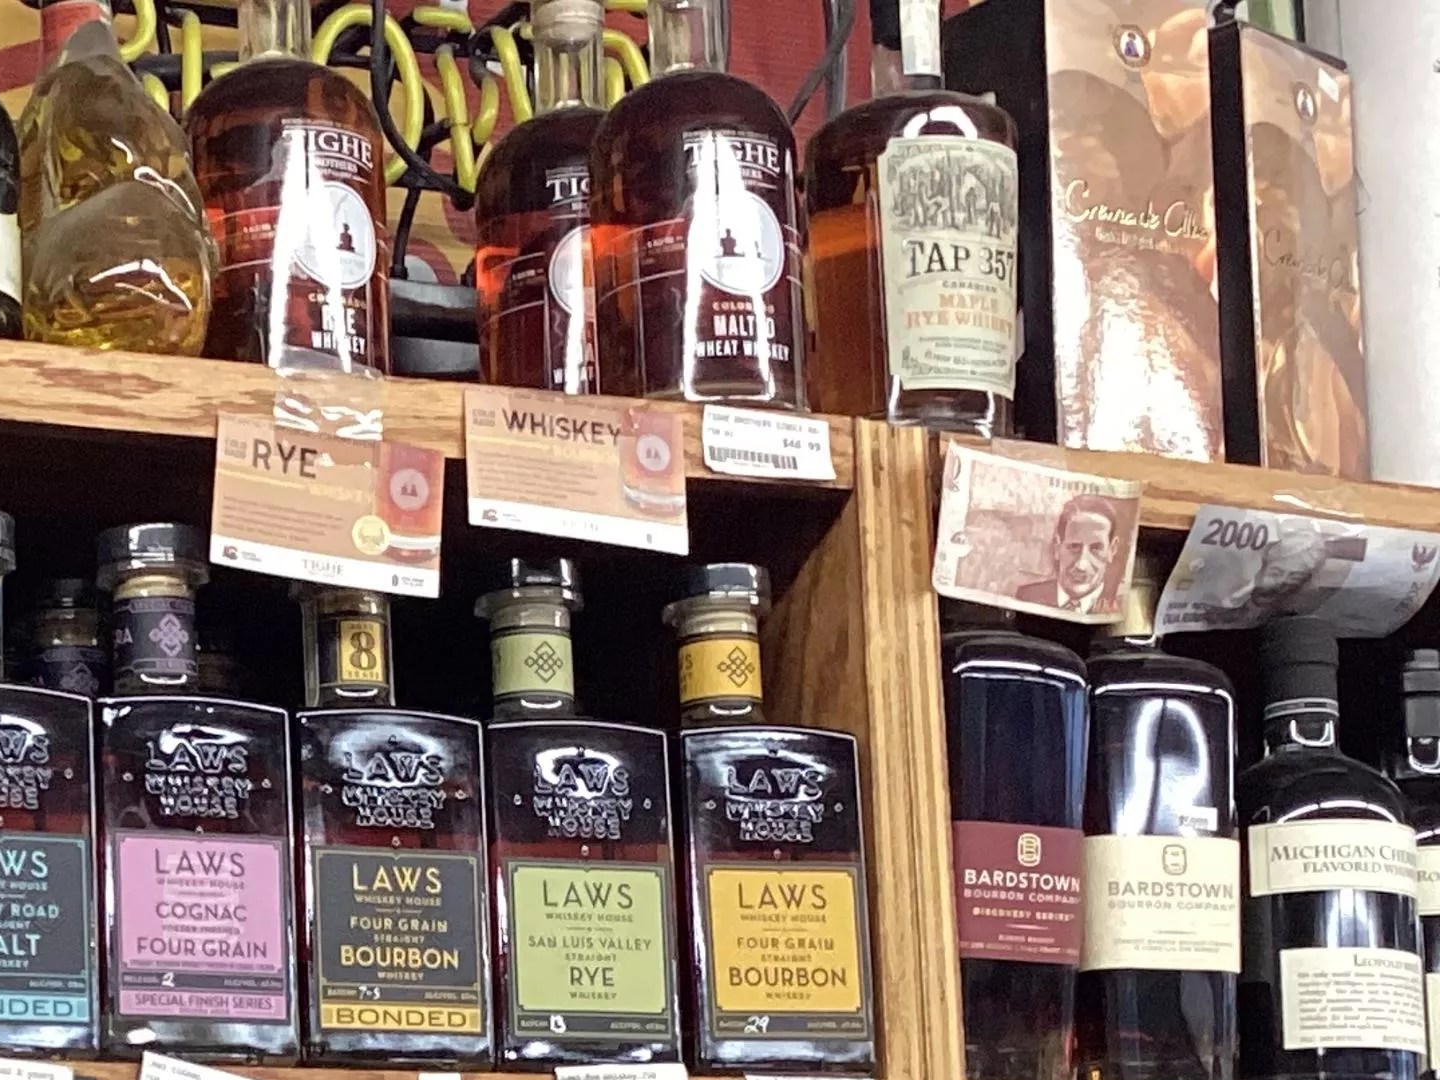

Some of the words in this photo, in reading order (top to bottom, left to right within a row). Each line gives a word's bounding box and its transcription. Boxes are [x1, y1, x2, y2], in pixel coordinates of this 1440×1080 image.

[906, 240, 970, 279] TAP
[980, 248, 1014, 288] 357
[501, 407, 622, 448] WHISKEY
[252, 439, 319, 479] RYE
[1202, 519, 1269, 551] 2000
[349, 631, 376, 671] 8
[155, 848, 246, 878] LAWS
[1271, 844, 1376, 862] MICHIGAN
[353, 863, 442, 893] LAWS
[964, 869, 1080, 892] BARDSTOWN
[543, 879, 634, 910] LAWS
[738, 883, 828, 910] LAWS
[964, 890, 1024, 901] BOURBON
[1108, 881, 1233, 899] BARDSTOWN
[11, 901, 60, 920] ROAD
[156, 903, 247, 922] COGNAC
[350, 916, 392, 932] FOUR
[397, 919, 448, 933] GRAIN
[136, 938, 196, 956] FOUR
[202, 939, 268, 959] GRAIN
[528, 935, 558, 948] SAN
[563, 936, 594, 949] LUIS
[600, 938, 652, 951] VALLEY
[737, 938, 780, 949] FOUR
[784, 938, 835, 951] GRAIN
[340, 944, 459, 970] BOURBON
[569, 967, 615, 987] RYE
[729, 967, 847, 987] BOURBON
[135, 994, 185, 1007] SPECIAL
[189, 995, 228, 1008] FINISH
[232, 997, 273, 1010] SERIES
[336, 1007, 467, 1028] BONDED
